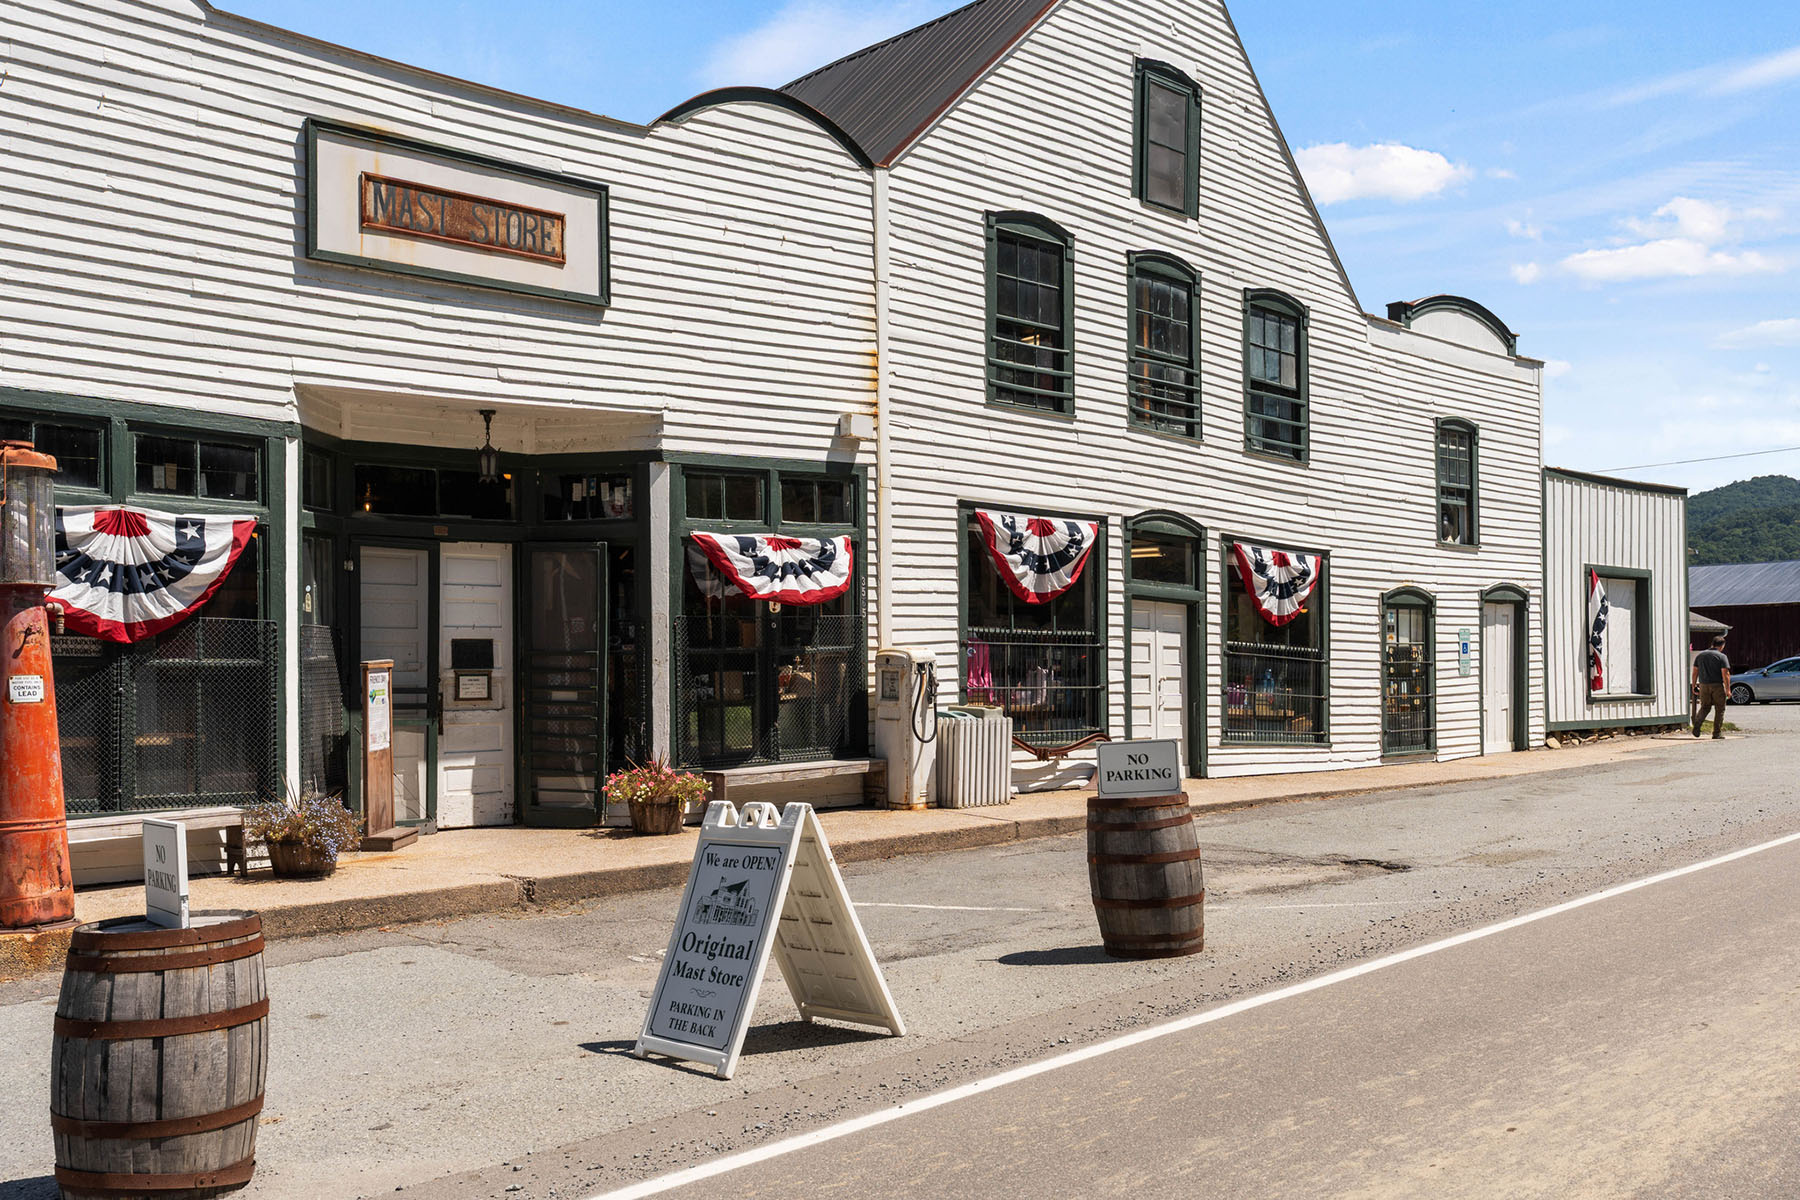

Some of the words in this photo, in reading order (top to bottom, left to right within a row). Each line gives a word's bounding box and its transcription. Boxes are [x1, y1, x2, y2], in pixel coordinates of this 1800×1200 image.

[373, 181, 452, 235] MAST
[470, 203, 556, 255] STORE
[1127, 753, 1149, 765] NO
[1106, 767, 1172, 782] PARKING
[155, 844, 166, 864] NO
[705, 852, 720, 868] We
[723, 857, 739, 869] are
[742, 854, 776, 871] OPEN!
[147, 869, 177, 893] PARKING
[682, 931, 753, 961] Original
[672, 960, 706, 981] Mast
[708, 966, 744, 987] Store
[669, 1000, 711, 1021] PARKING
[713, 1009, 726, 1021] IN
[669, 1017, 688, 1033] THE
[689, 1022, 717, 1038] BACK
